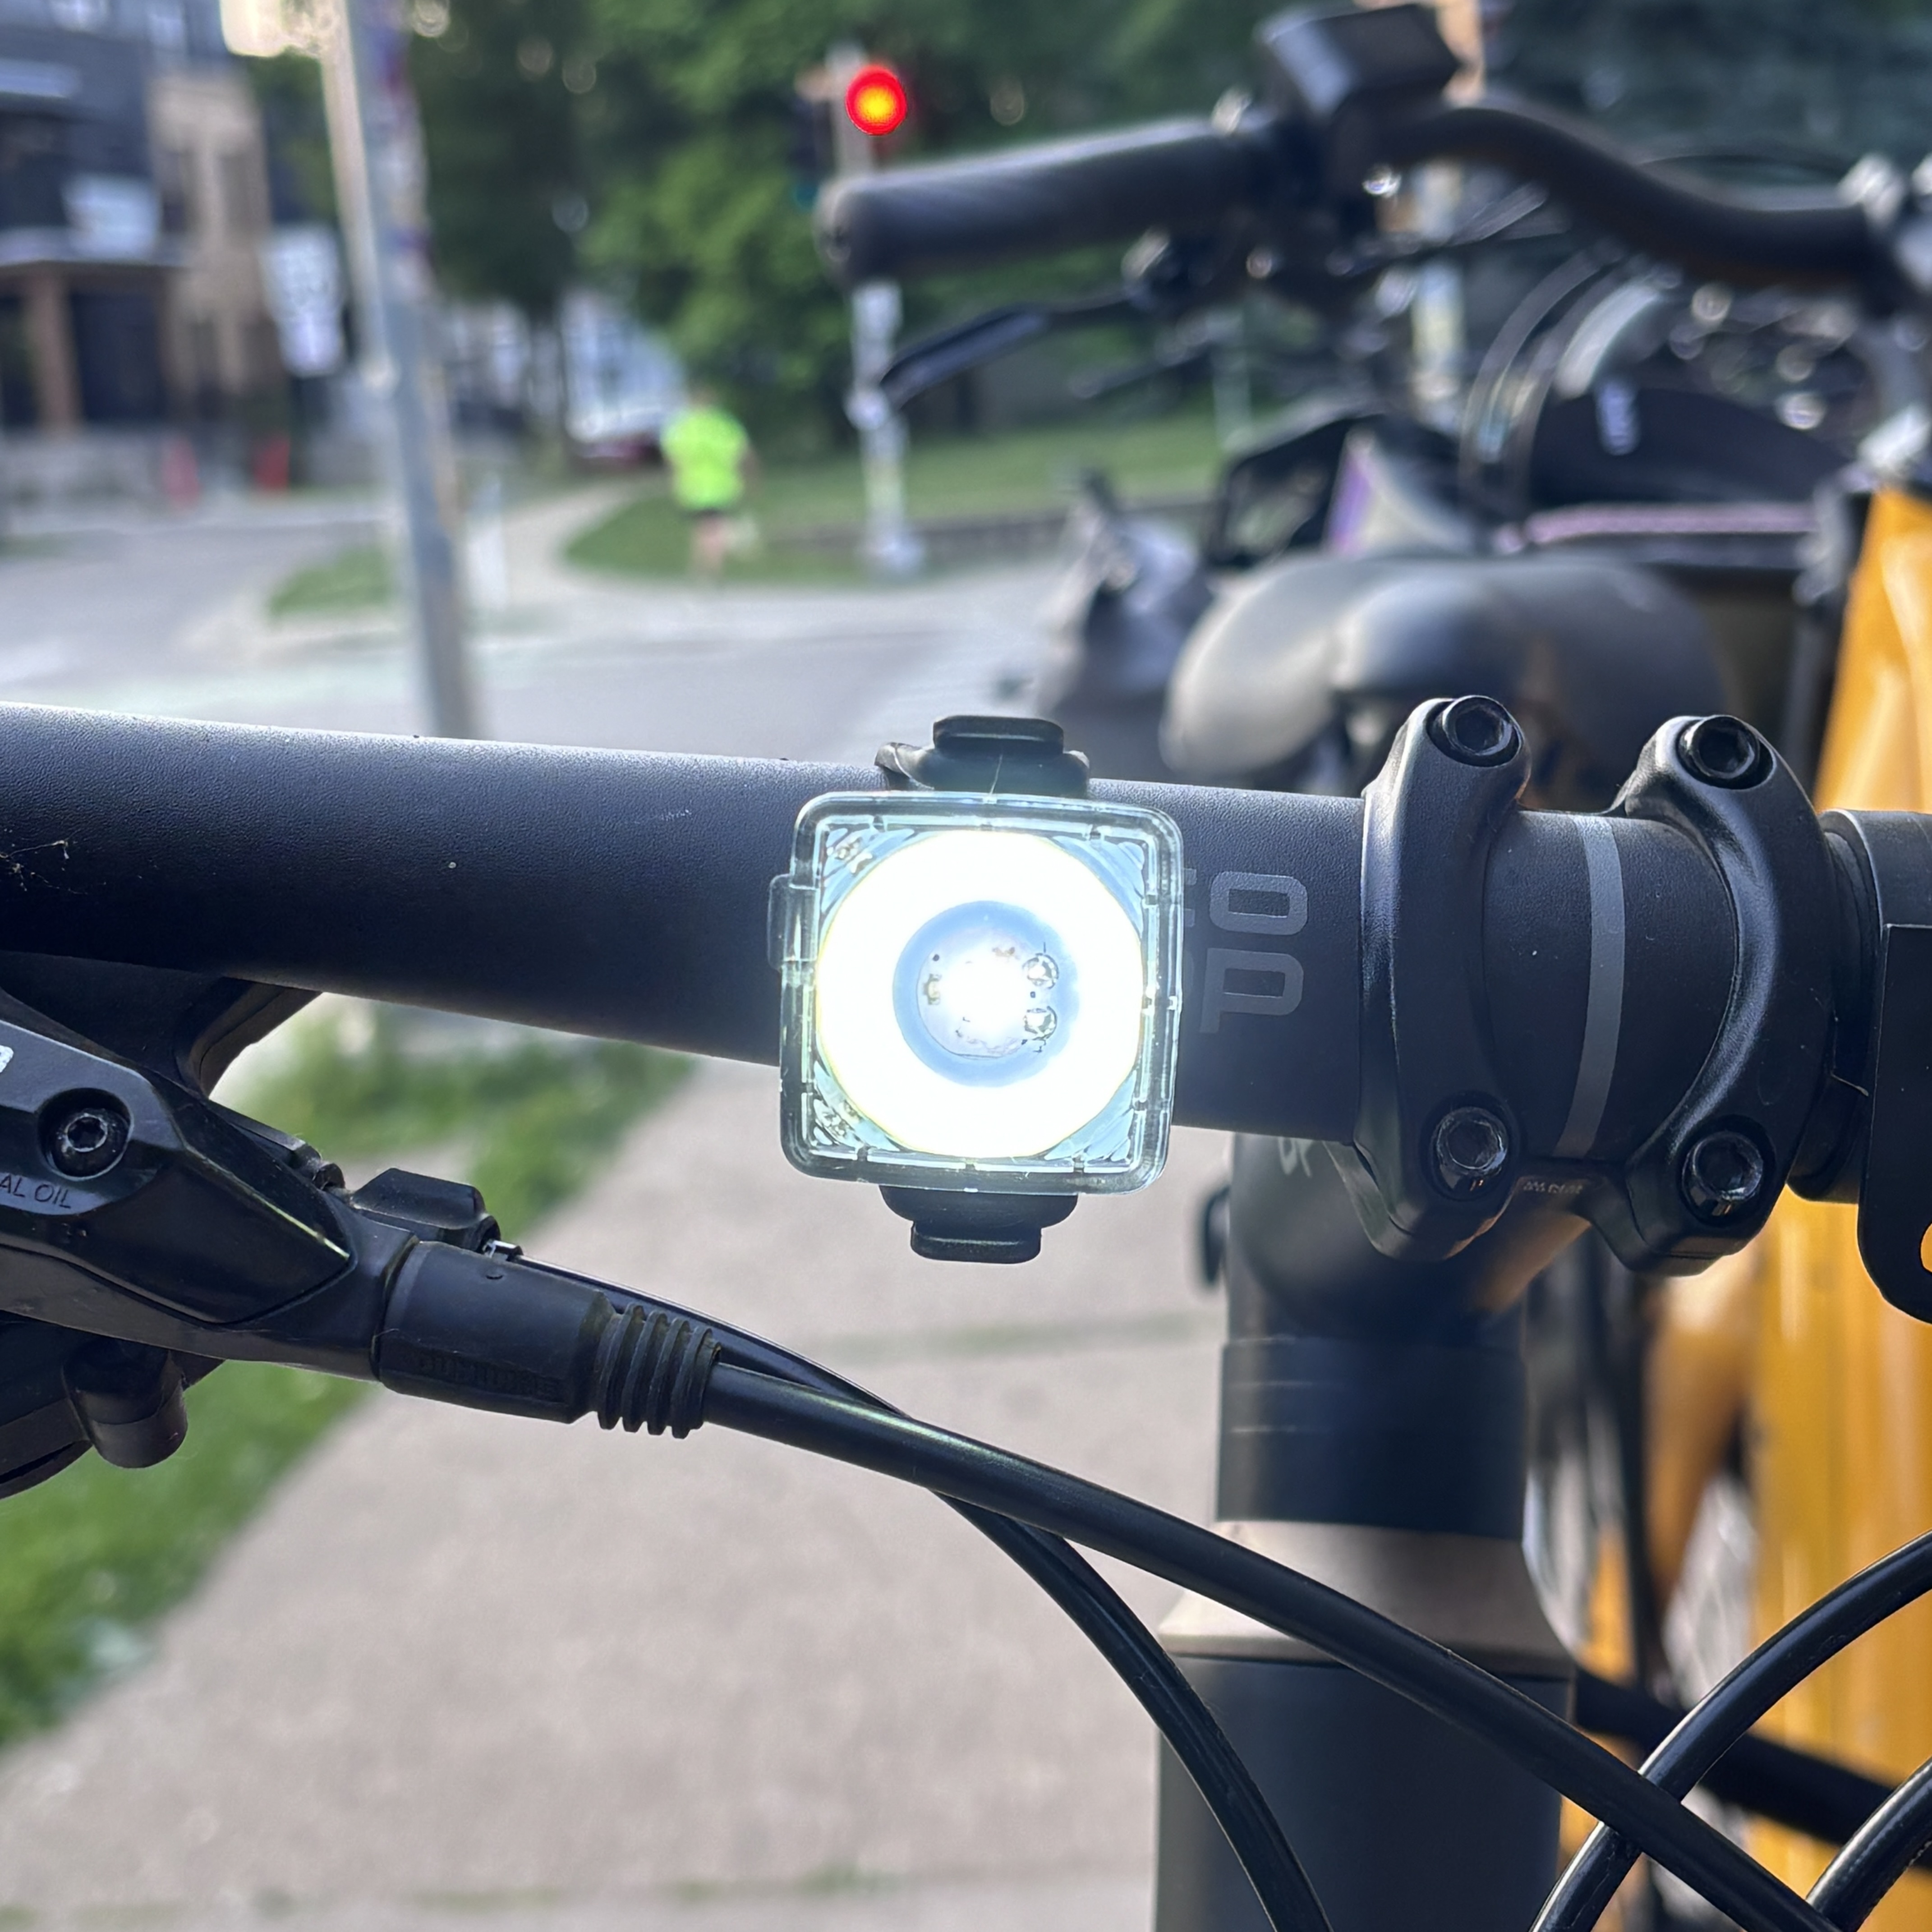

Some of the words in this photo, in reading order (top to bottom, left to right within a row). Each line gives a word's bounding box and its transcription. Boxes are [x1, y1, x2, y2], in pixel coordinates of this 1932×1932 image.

[1184, 868, 1308, 935] O
[1184, 948, 1304, 1033] P
[34, 1184, 72, 1209] OIL
